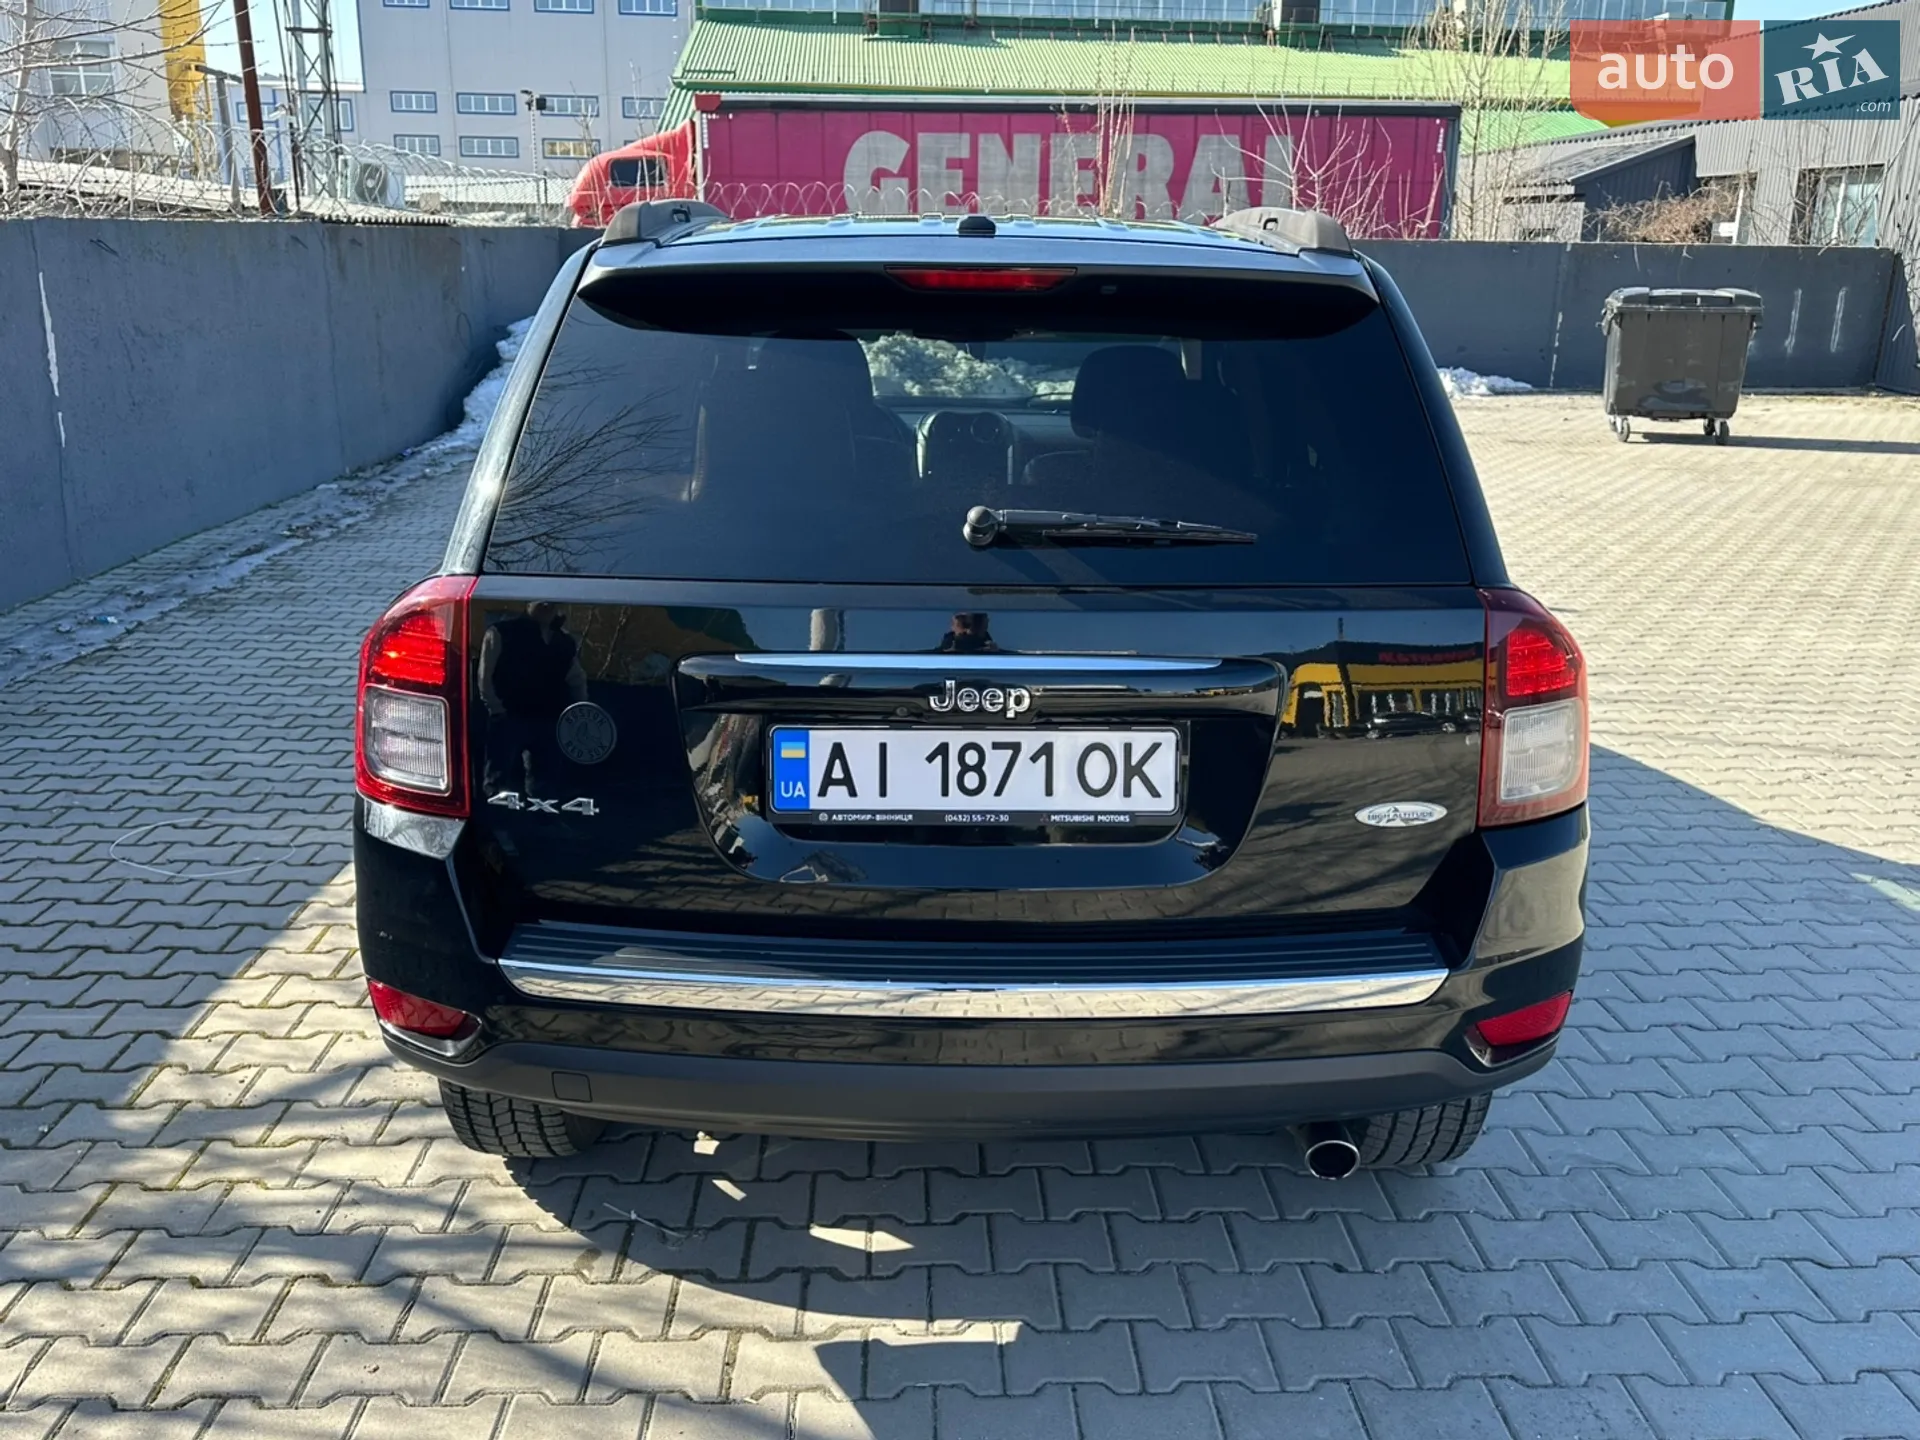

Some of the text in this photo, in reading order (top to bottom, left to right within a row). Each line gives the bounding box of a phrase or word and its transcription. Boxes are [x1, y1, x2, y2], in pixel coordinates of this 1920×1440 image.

[929, 680, 1031, 718] Jeep
[817, 742, 1162, 798] AI 1871 OK
[780, 781, 806, 798] UA
[1050, 814, 1130, 823] MITSUBISHI MOTORS
